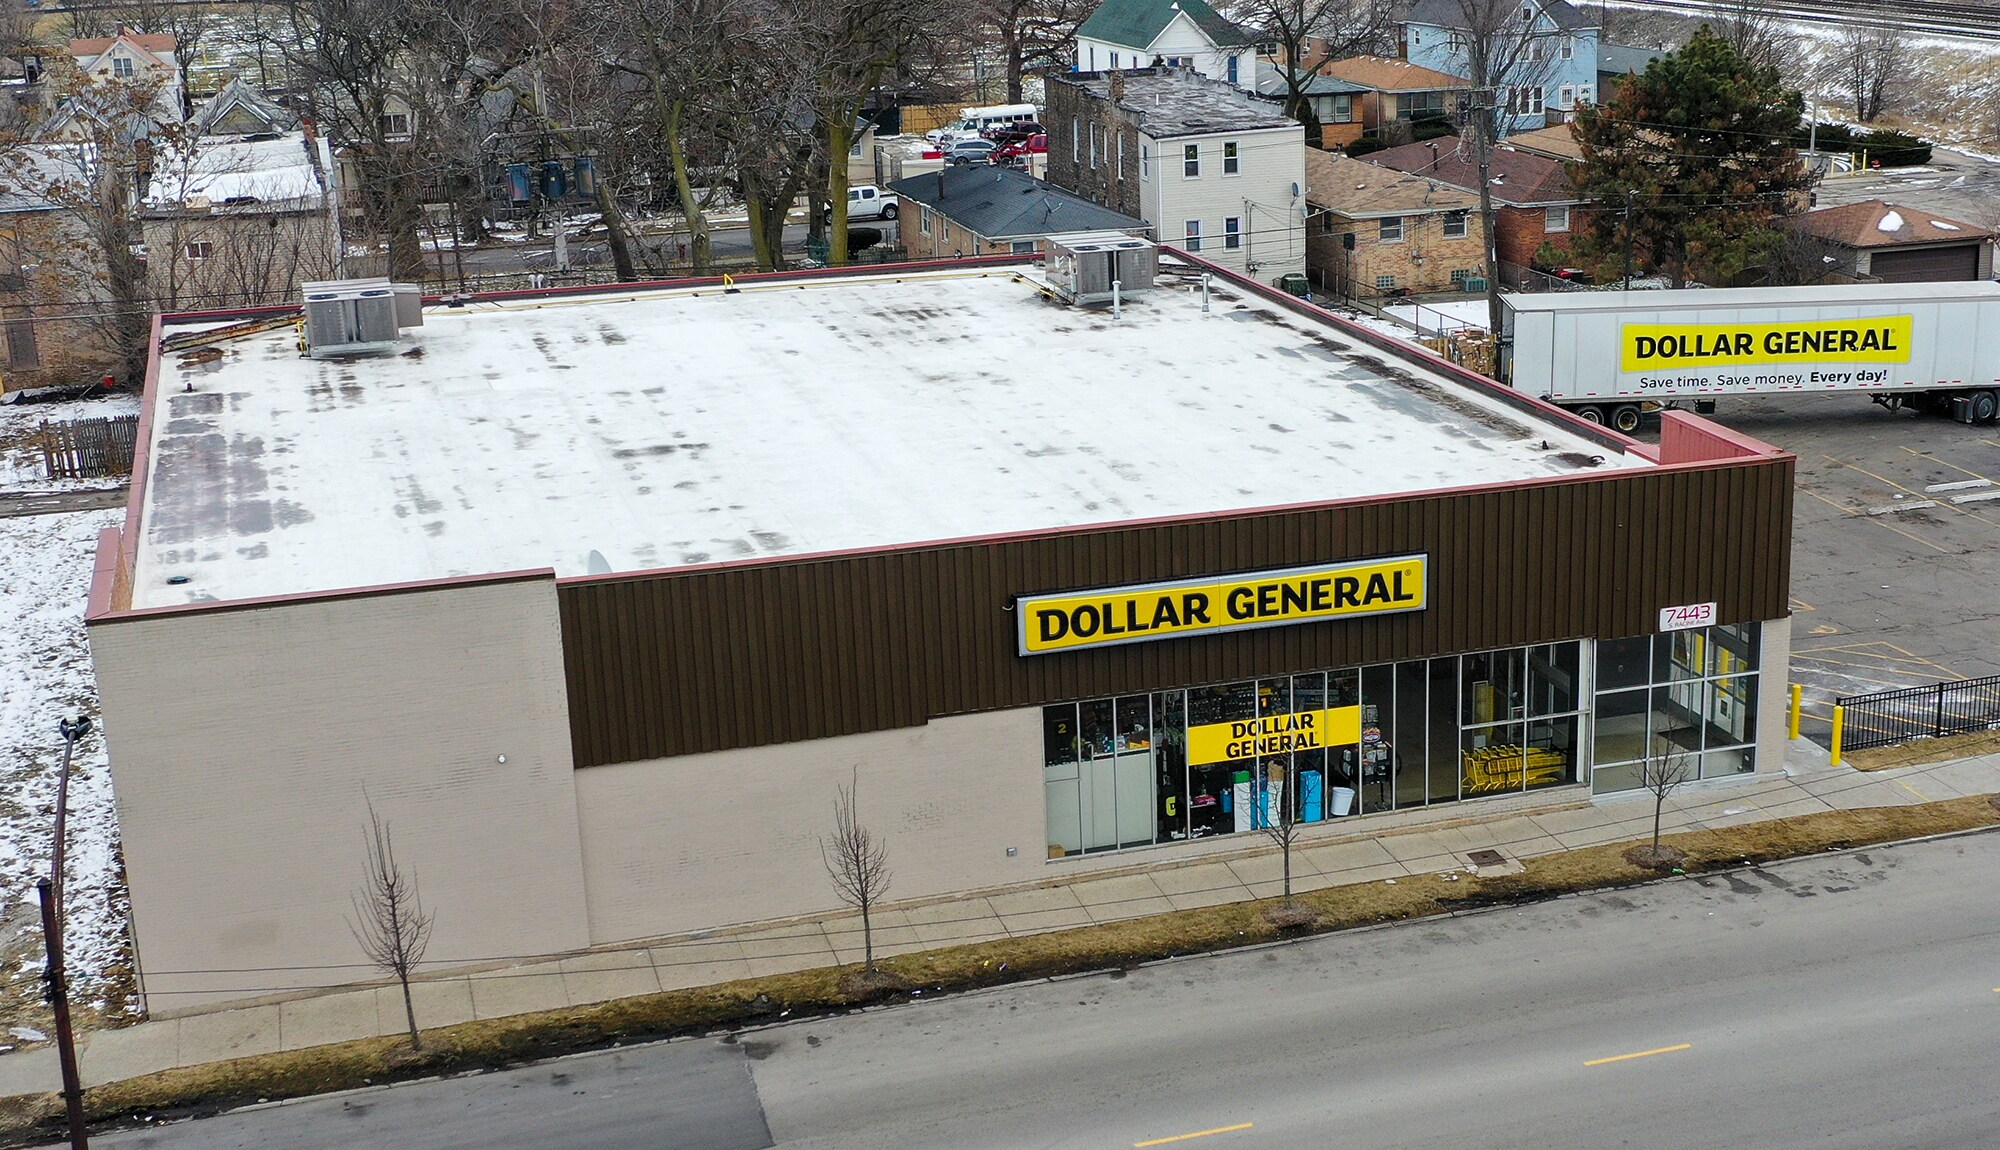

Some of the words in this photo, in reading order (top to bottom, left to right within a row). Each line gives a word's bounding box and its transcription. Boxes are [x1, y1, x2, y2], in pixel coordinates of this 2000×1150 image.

[1635, 333, 1753, 358] DOLLAR
[1763, 329, 1897, 354] GENERAL
[1640, 377, 1673, 389] Save
[1676, 374, 1711, 388] time.
[1716, 374, 1750, 386] Save
[1755, 373, 1806, 387] money.
[1810, 371, 1852, 386] Every
[1856, 369, 1888, 385] day!
[1036, 593, 1211, 642] DOLLAR
[1226, 570, 1414, 620] GENERAL
[1665, 605, 1710, 623] 7443
[1057, 723, 1067, 734] 2
[1231, 713, 1314, 739] DOLLAR
[1226, 732, 1320, 758] GENERAL
